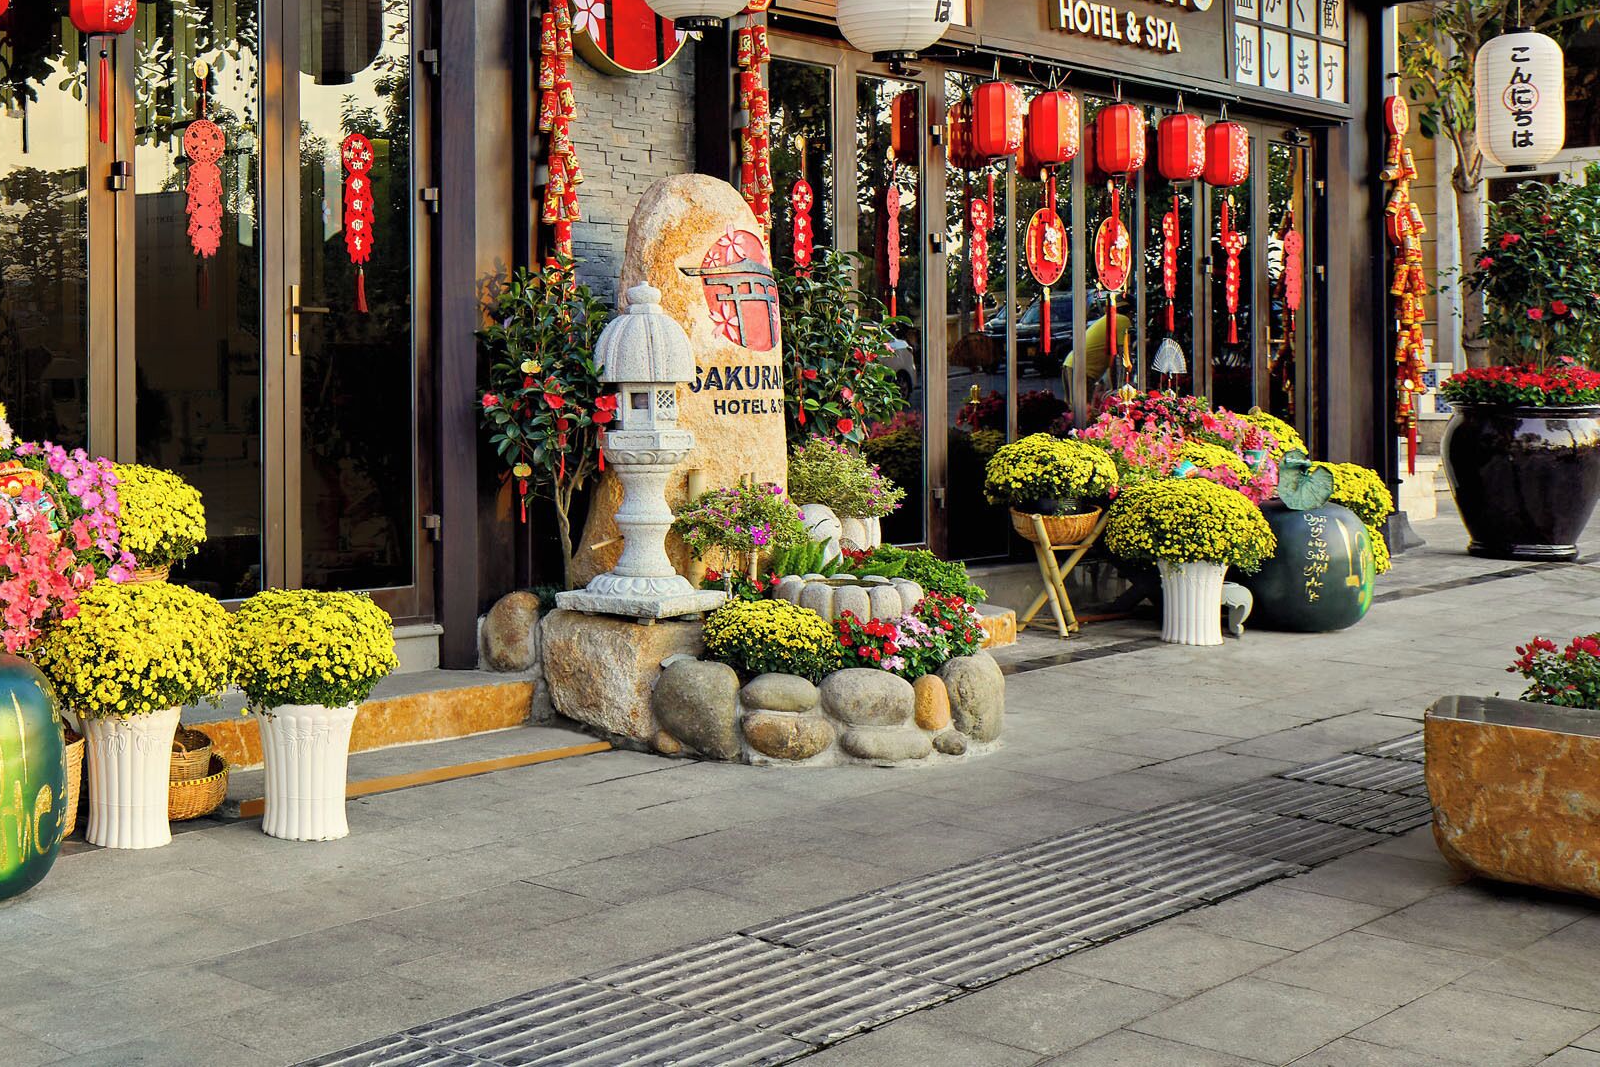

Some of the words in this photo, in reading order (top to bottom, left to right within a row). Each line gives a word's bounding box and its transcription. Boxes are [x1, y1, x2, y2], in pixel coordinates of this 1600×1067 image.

[1126, 11, 1141, 43] &
[1146, 15, 1181, 53] SPA
[1510, 46, 1535, 149] こんにちは
[713, 399, 768, 415] HOTEL
